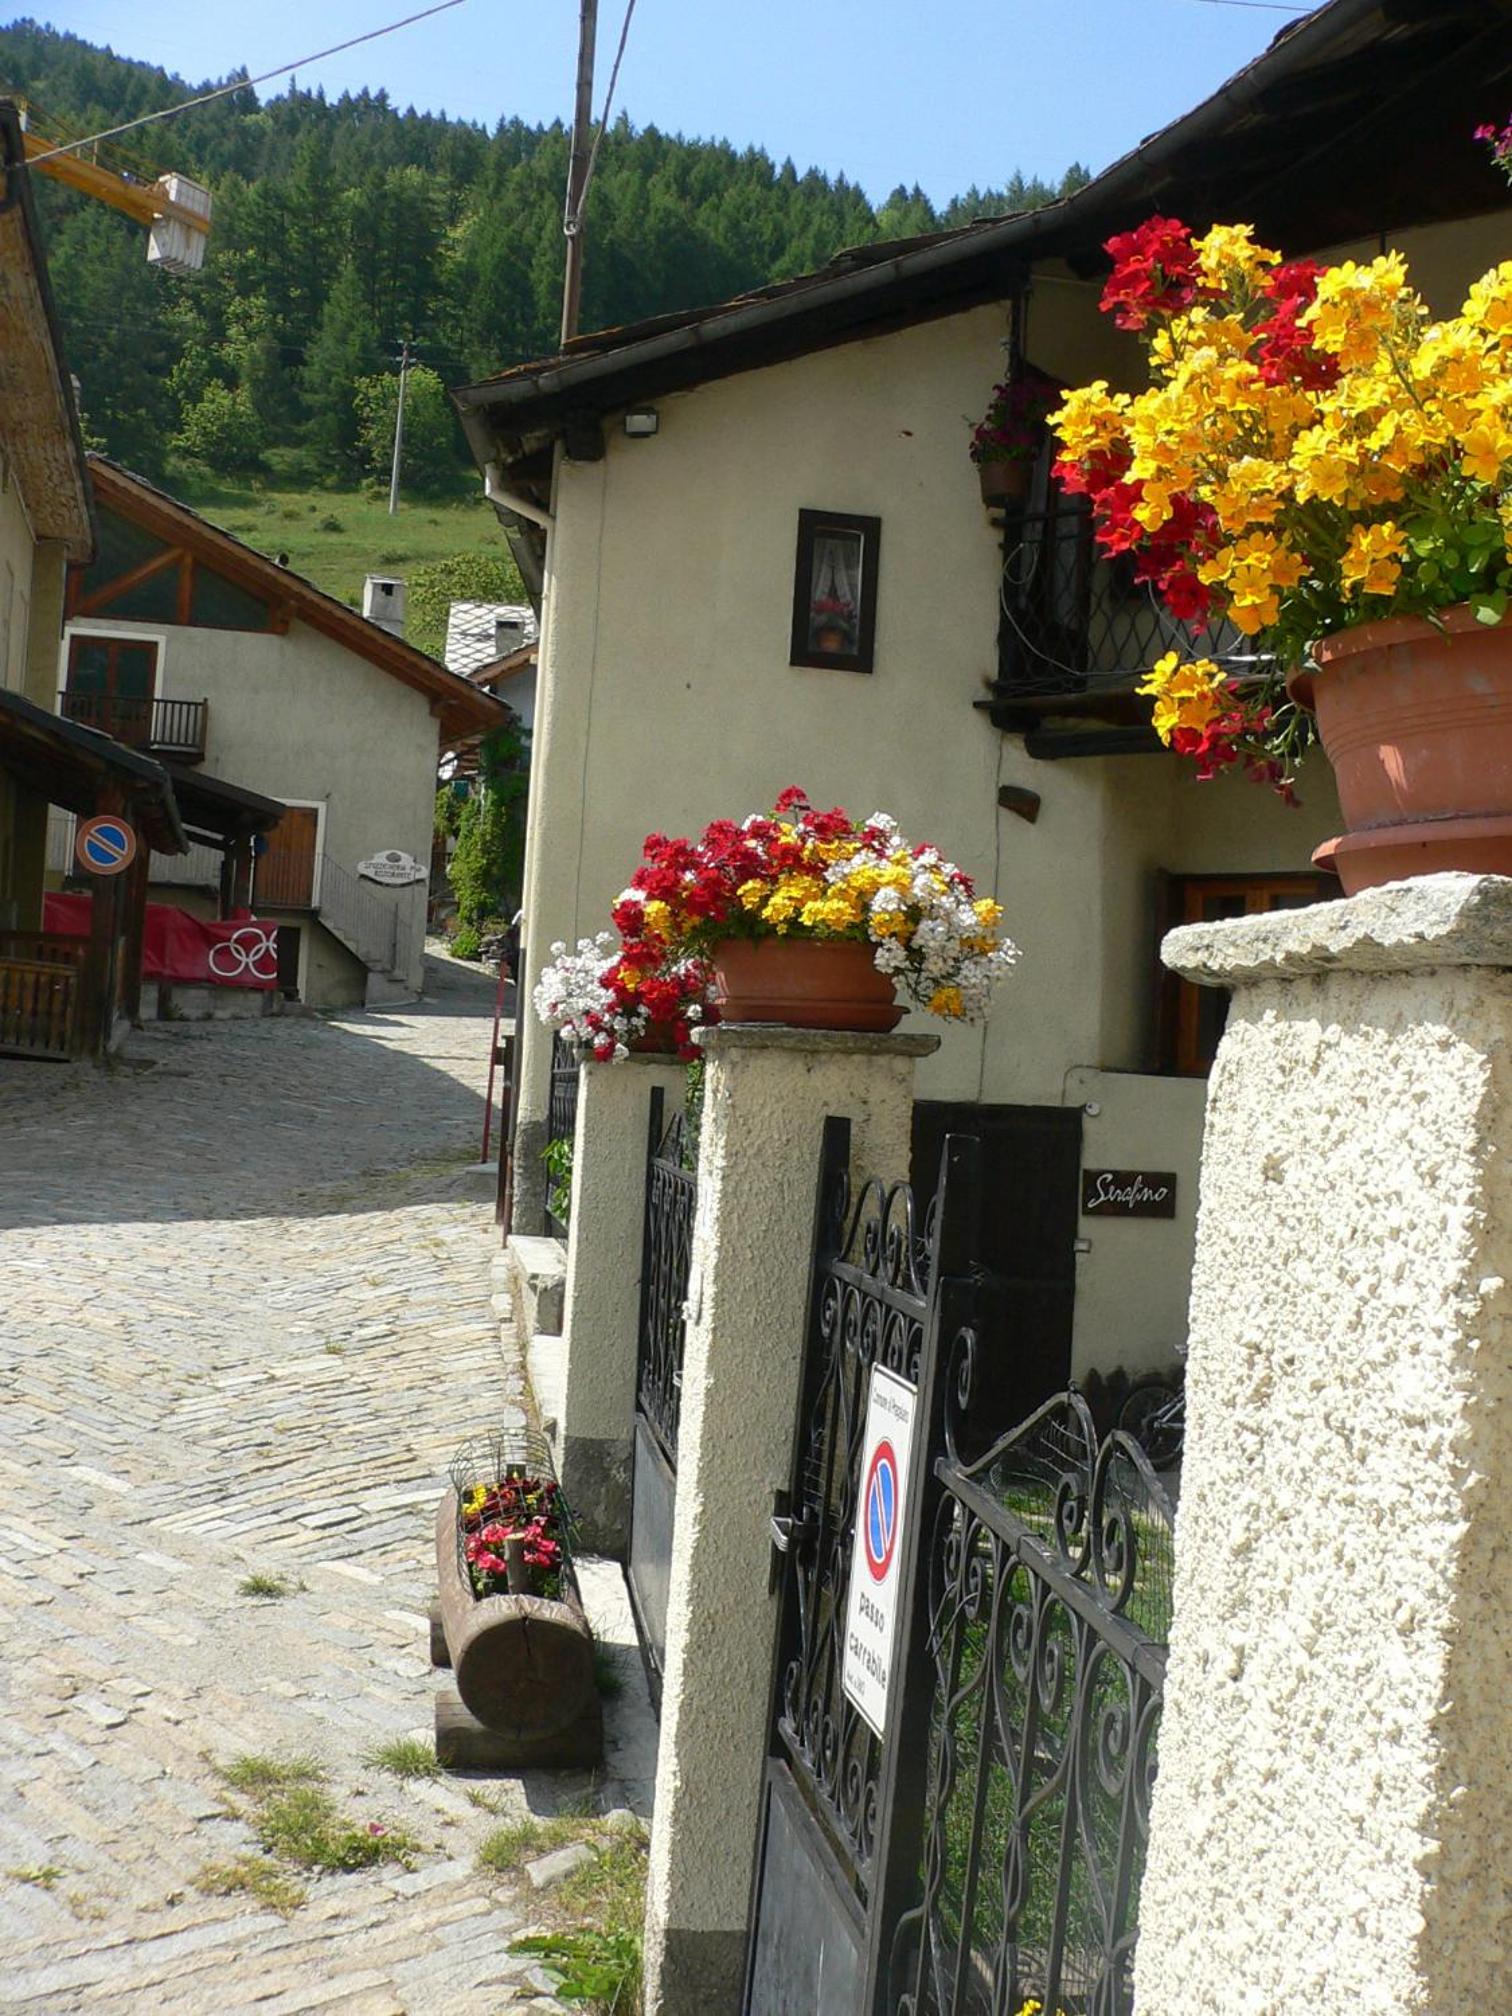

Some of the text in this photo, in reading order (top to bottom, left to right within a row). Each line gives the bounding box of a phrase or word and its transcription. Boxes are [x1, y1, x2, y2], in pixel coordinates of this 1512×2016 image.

[1087, 1173, 1168, 1208] Serafino
[859, 1591, 885, 1633] passo
[849, 1631, 886, 1690] carrabile
